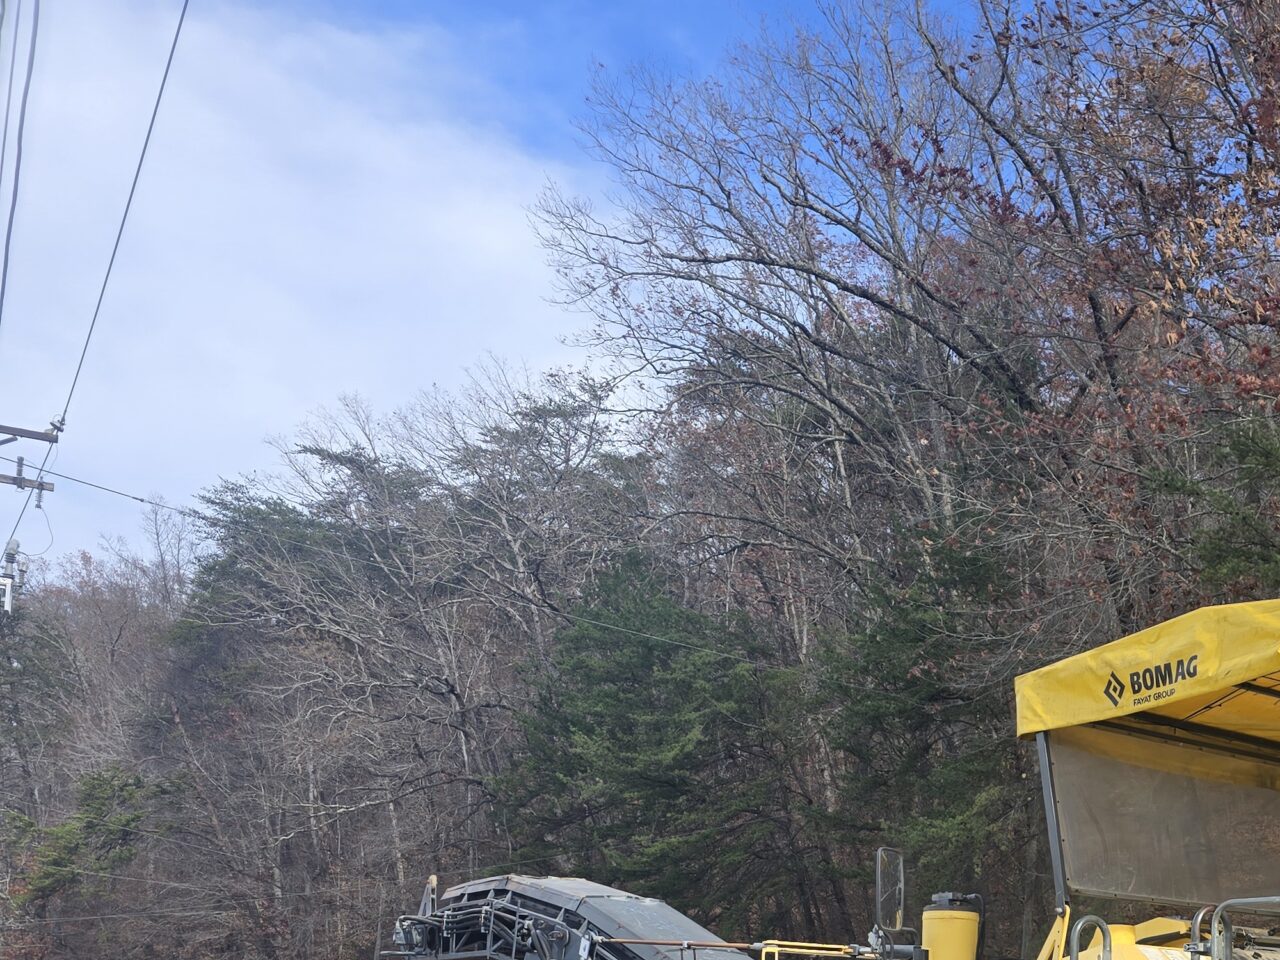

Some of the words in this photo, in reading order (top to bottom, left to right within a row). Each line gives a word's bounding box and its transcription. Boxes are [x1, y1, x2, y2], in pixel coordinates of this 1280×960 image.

[1129, 655, 1198, 695] BOMAG
[1133, 694, 1152, 706] FAYAT
[1153, 688, 1176, 701] GROUP
